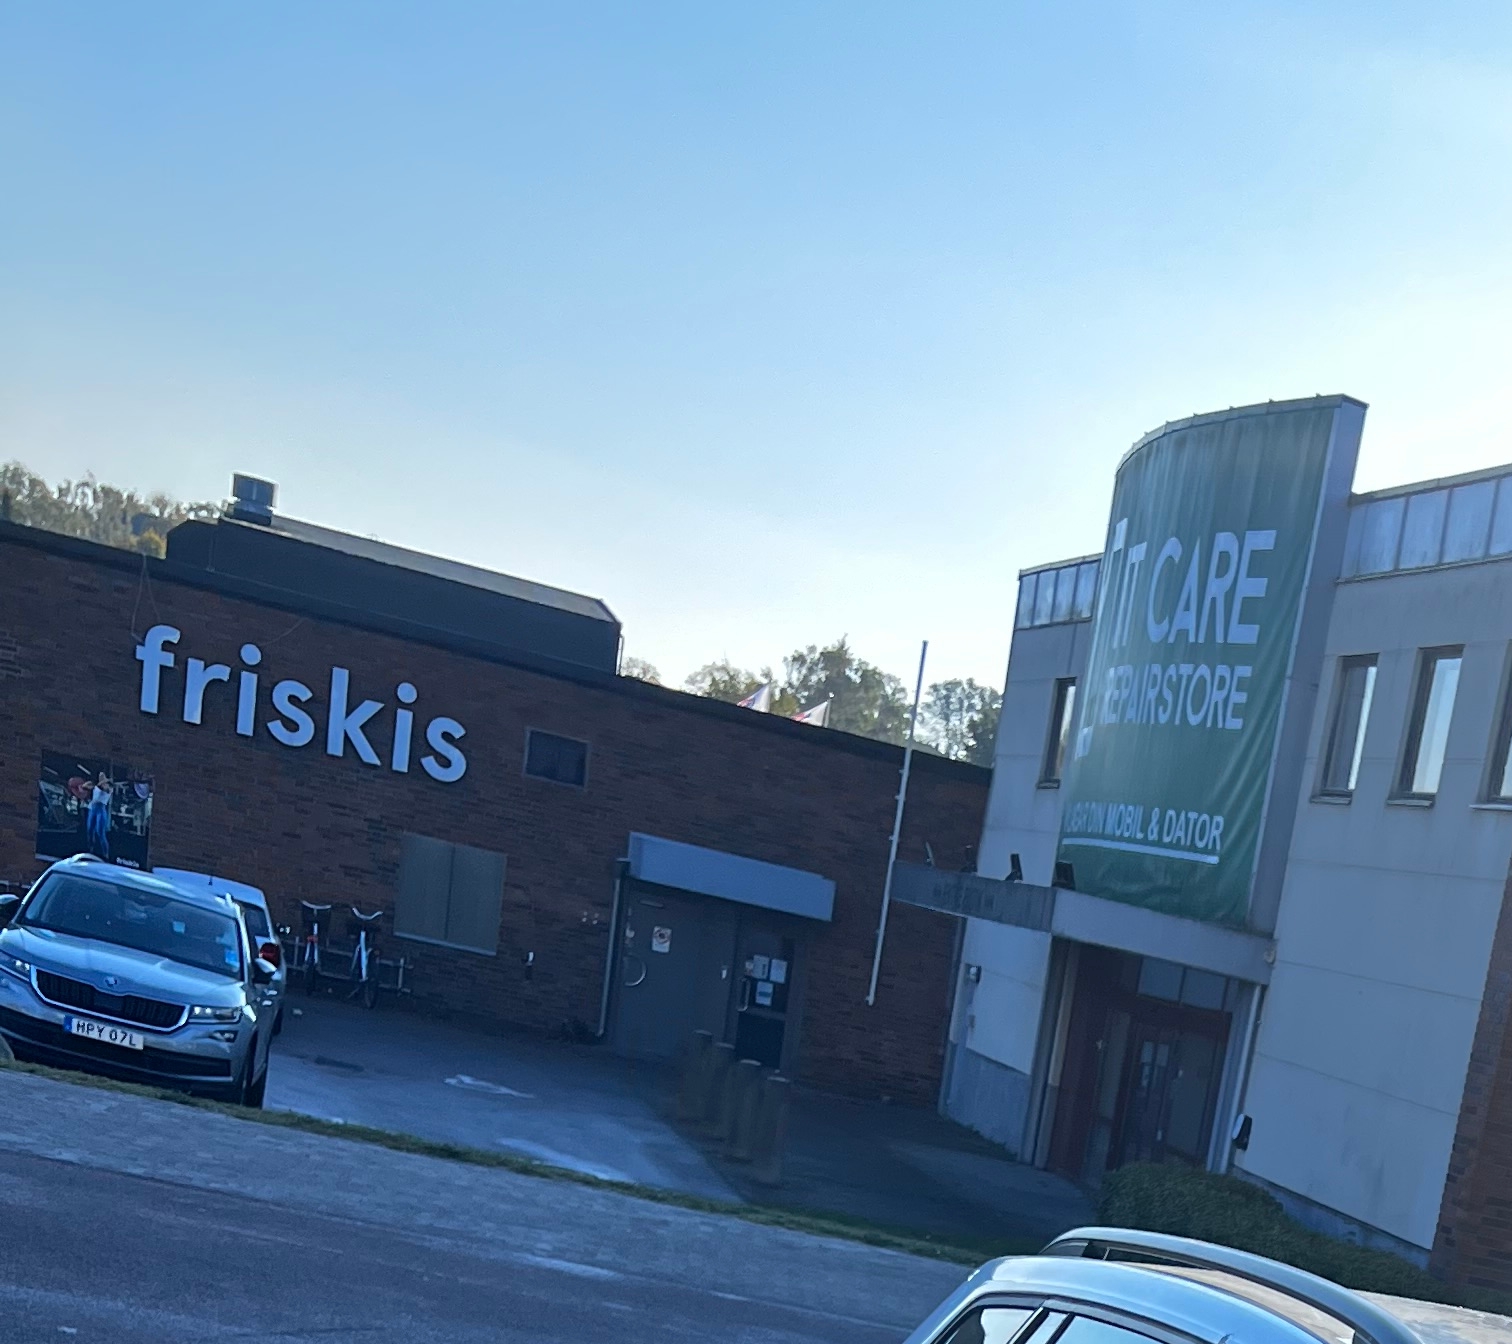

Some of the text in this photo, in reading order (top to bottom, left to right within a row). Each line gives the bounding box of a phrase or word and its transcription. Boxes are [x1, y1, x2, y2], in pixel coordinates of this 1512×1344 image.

[1147, 530, 1277, 644] CARE
[136, 624, 467, 782] friskis
[1104, 803, 1145, 839] MOBIL
[1148, 807, 1160, 840] &
[1162, 809, 1224, 850] DATOR
[76, 1020, 105, 1038] HPY
